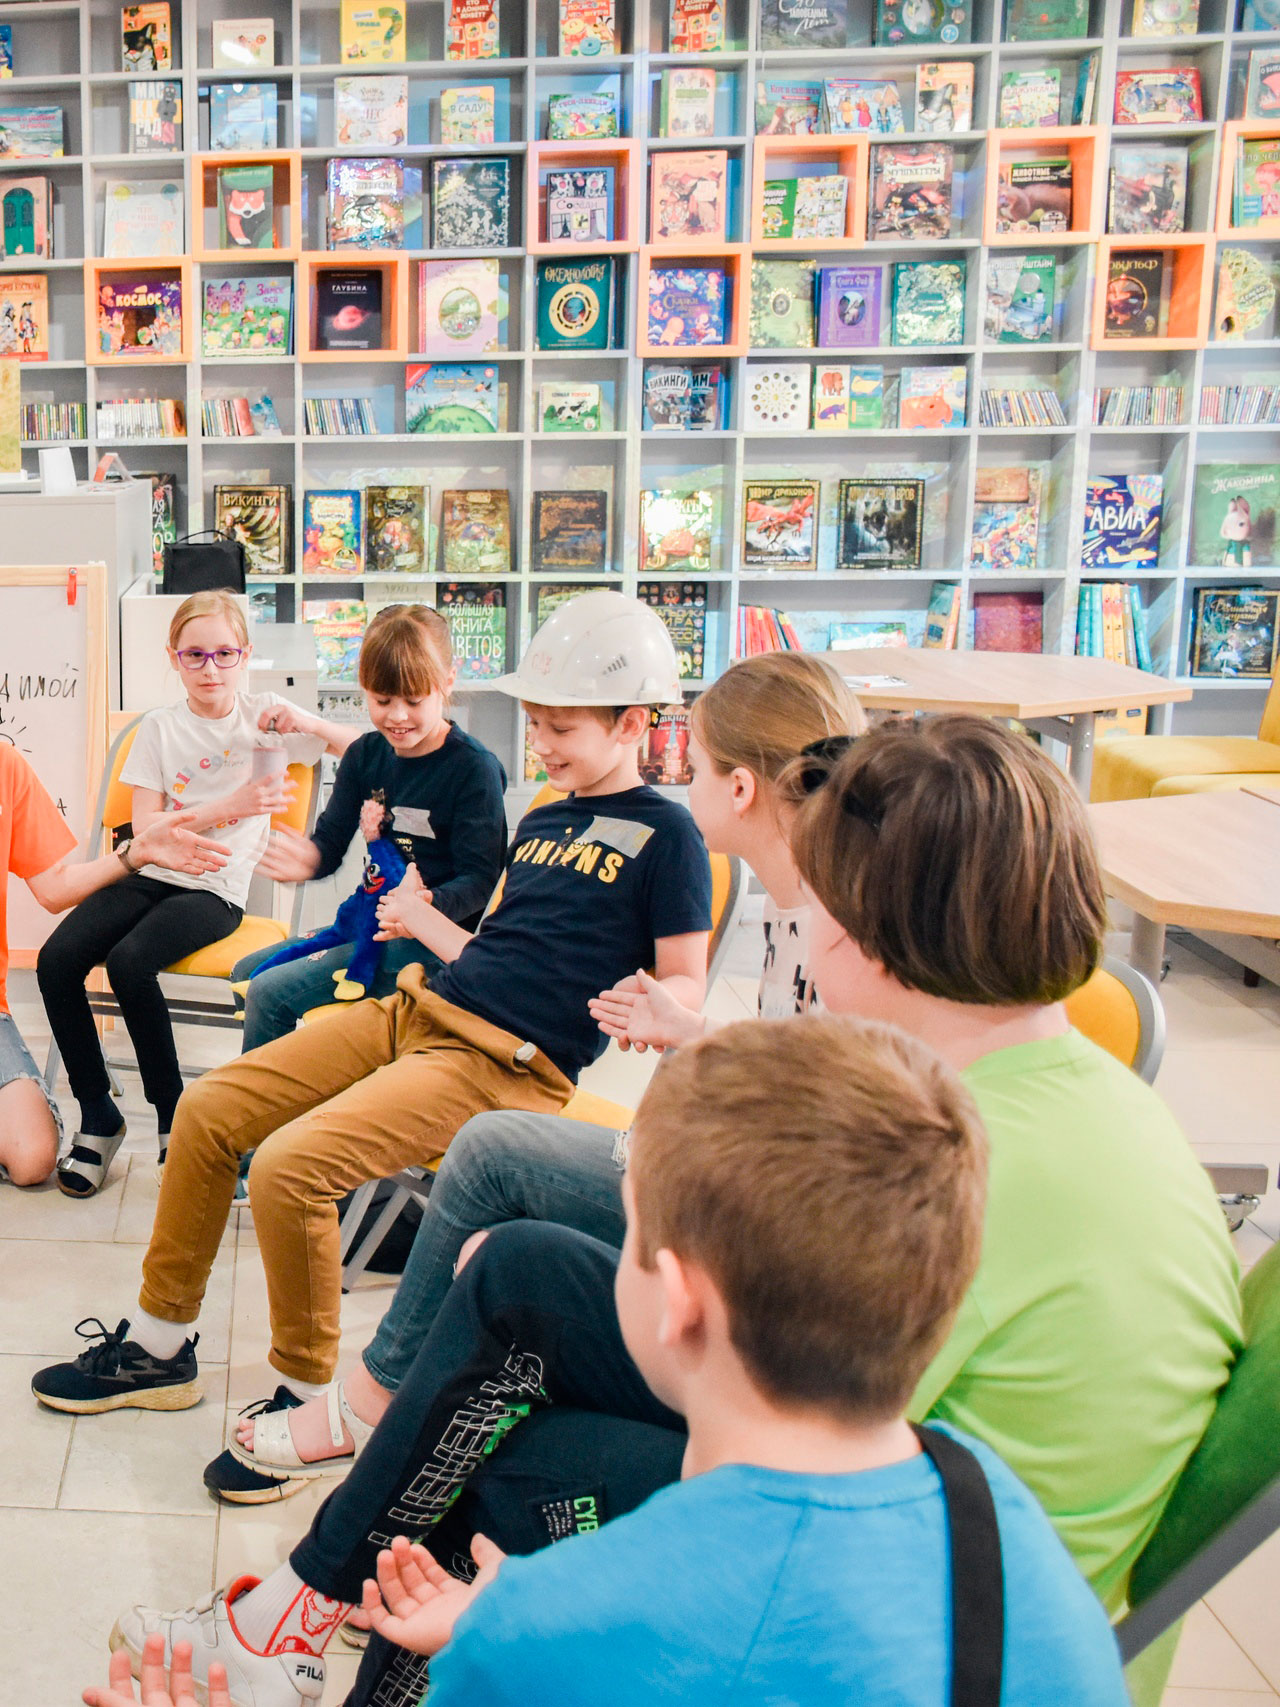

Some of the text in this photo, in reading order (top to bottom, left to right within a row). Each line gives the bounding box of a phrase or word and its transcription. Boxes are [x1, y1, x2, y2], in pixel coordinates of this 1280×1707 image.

[332, 284, 368, 292] ГЛУБИНА
[115, 292, 163, 307] КОСМОС
[650, 374, 688, 390] ВИКИНГИ
[223, 493, 279, 507] ВИКИНГИ
[1089, 507, 1147, 531] АВИА
[448, 602, 495, 617] БОЛЬШАЯ
[451, 619, 494, 634] КНИГА
[296, 1664, 325, 1682] FILA
